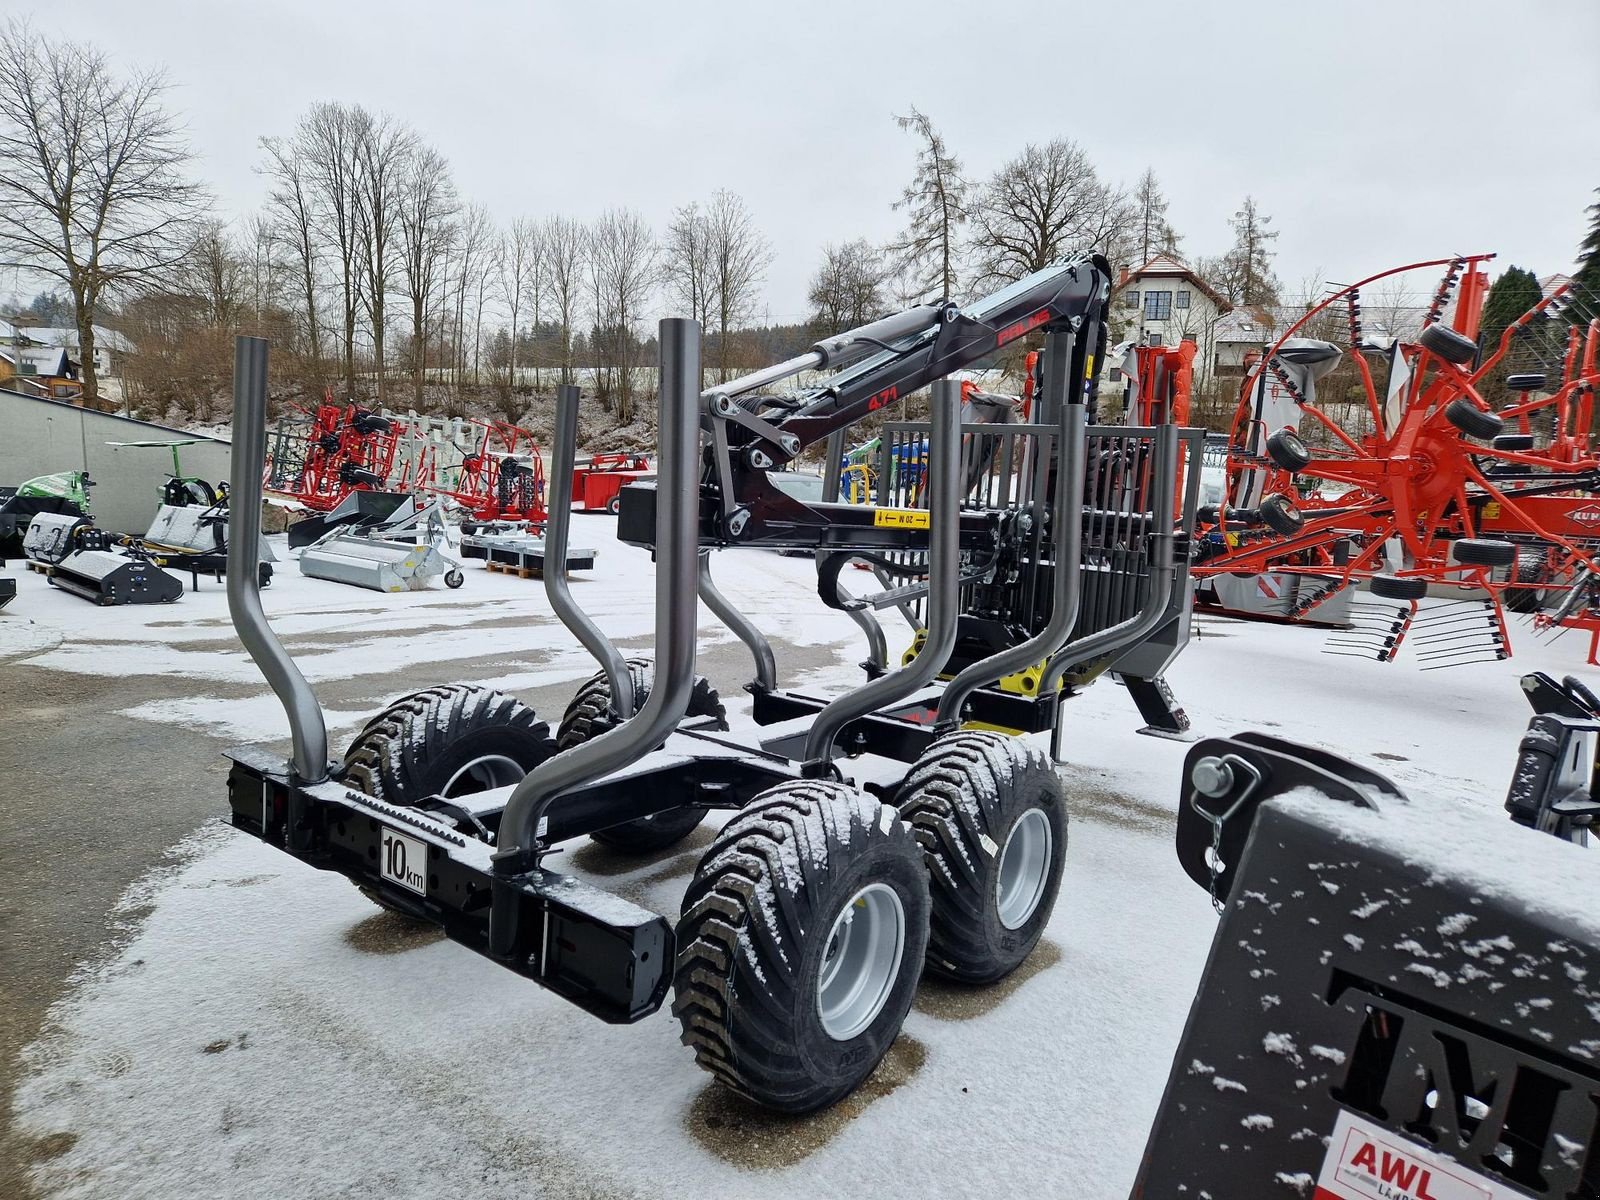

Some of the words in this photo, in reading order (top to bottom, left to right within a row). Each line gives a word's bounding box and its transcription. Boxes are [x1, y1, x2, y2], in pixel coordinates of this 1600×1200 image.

[996, 308, 1051, 347] PALMS
[383, 835, 407, 880] 10
[406, 865, 424, 890] km
[1350, 1141, 1437, 1200] AWL
